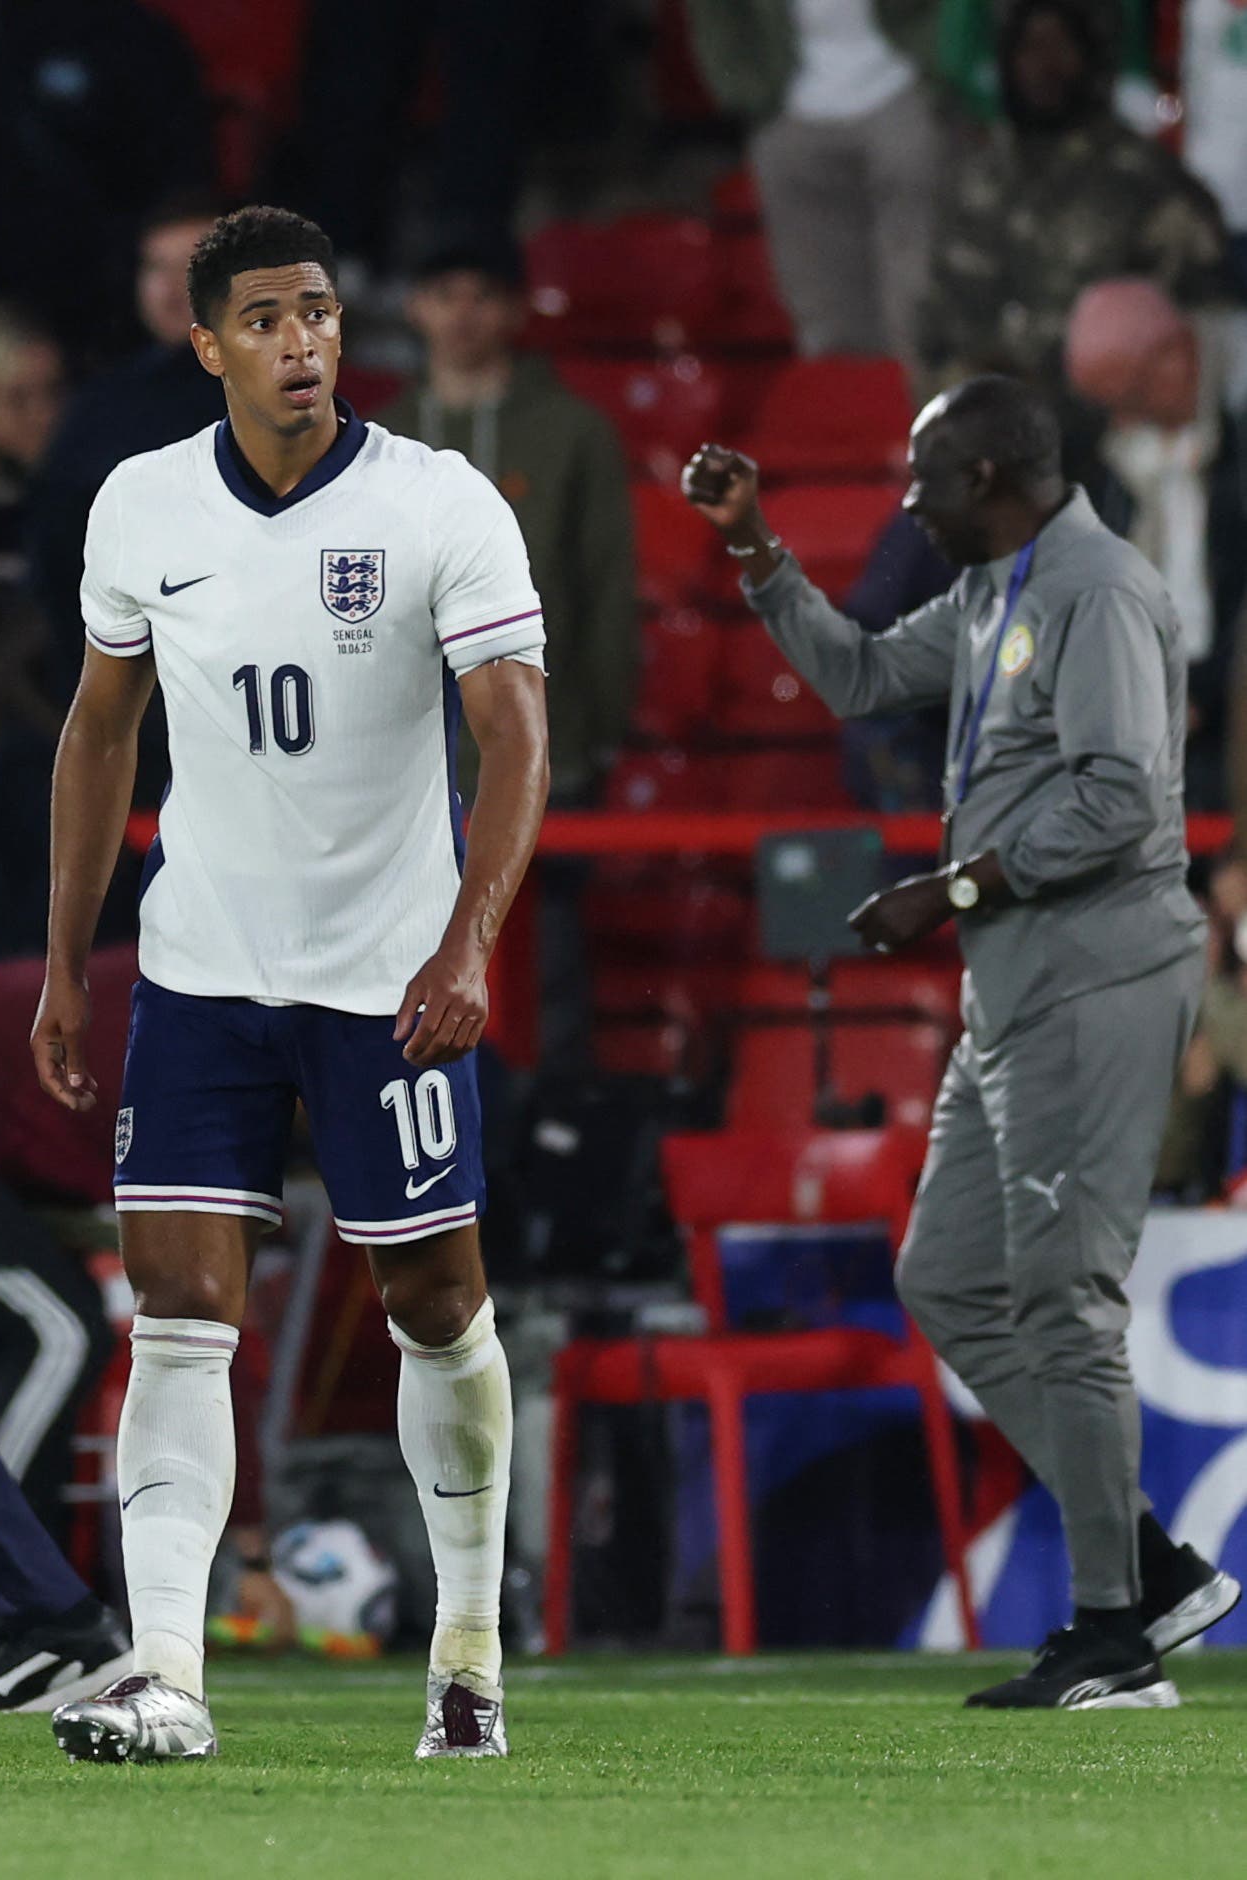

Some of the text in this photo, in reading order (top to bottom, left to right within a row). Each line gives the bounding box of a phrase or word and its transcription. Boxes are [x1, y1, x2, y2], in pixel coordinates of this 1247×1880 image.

[333, 629, 374, 641] SENEGAL
[337, 641, 372, 655] 10.06.25
[233, 664, 316, 756] 10
[379, 1069, 457, 1170] 10
